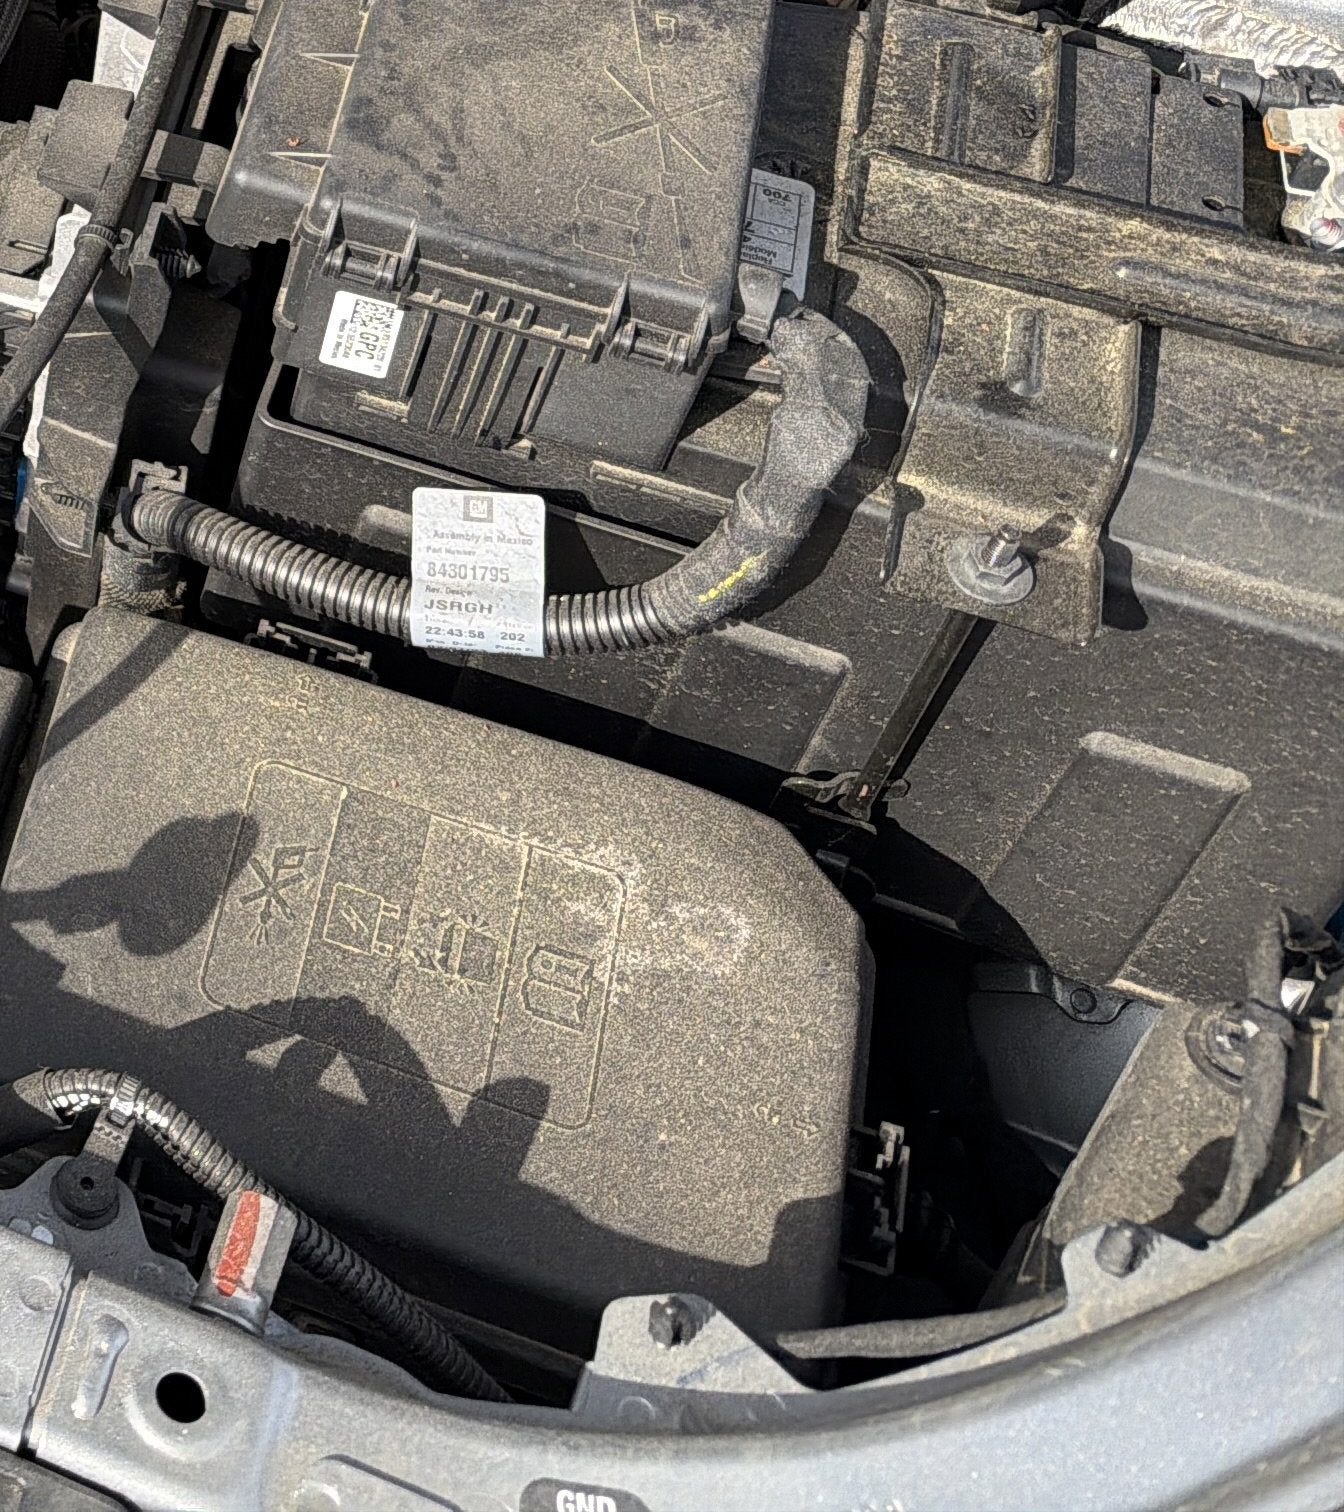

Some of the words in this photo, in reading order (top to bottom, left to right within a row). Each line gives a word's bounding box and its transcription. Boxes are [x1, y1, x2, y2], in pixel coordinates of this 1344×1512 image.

[762, 188, 791, 201] 700
[767, 198, 785, 206] CCA
[353, 330, 380, 360] GPC
[433, 530, 481, 544] Assembly
[484, 534, 494, 543] in
[496, 534, 534, 546] Mexico
[426, 561, 510, 583] 84301795
[424, 600, 493, 614] JSRGH
[425, 625, 485, 640] 22:43:58
[500, 631, 526, 642] 202
[556, 1489, 616, 1512] GND
